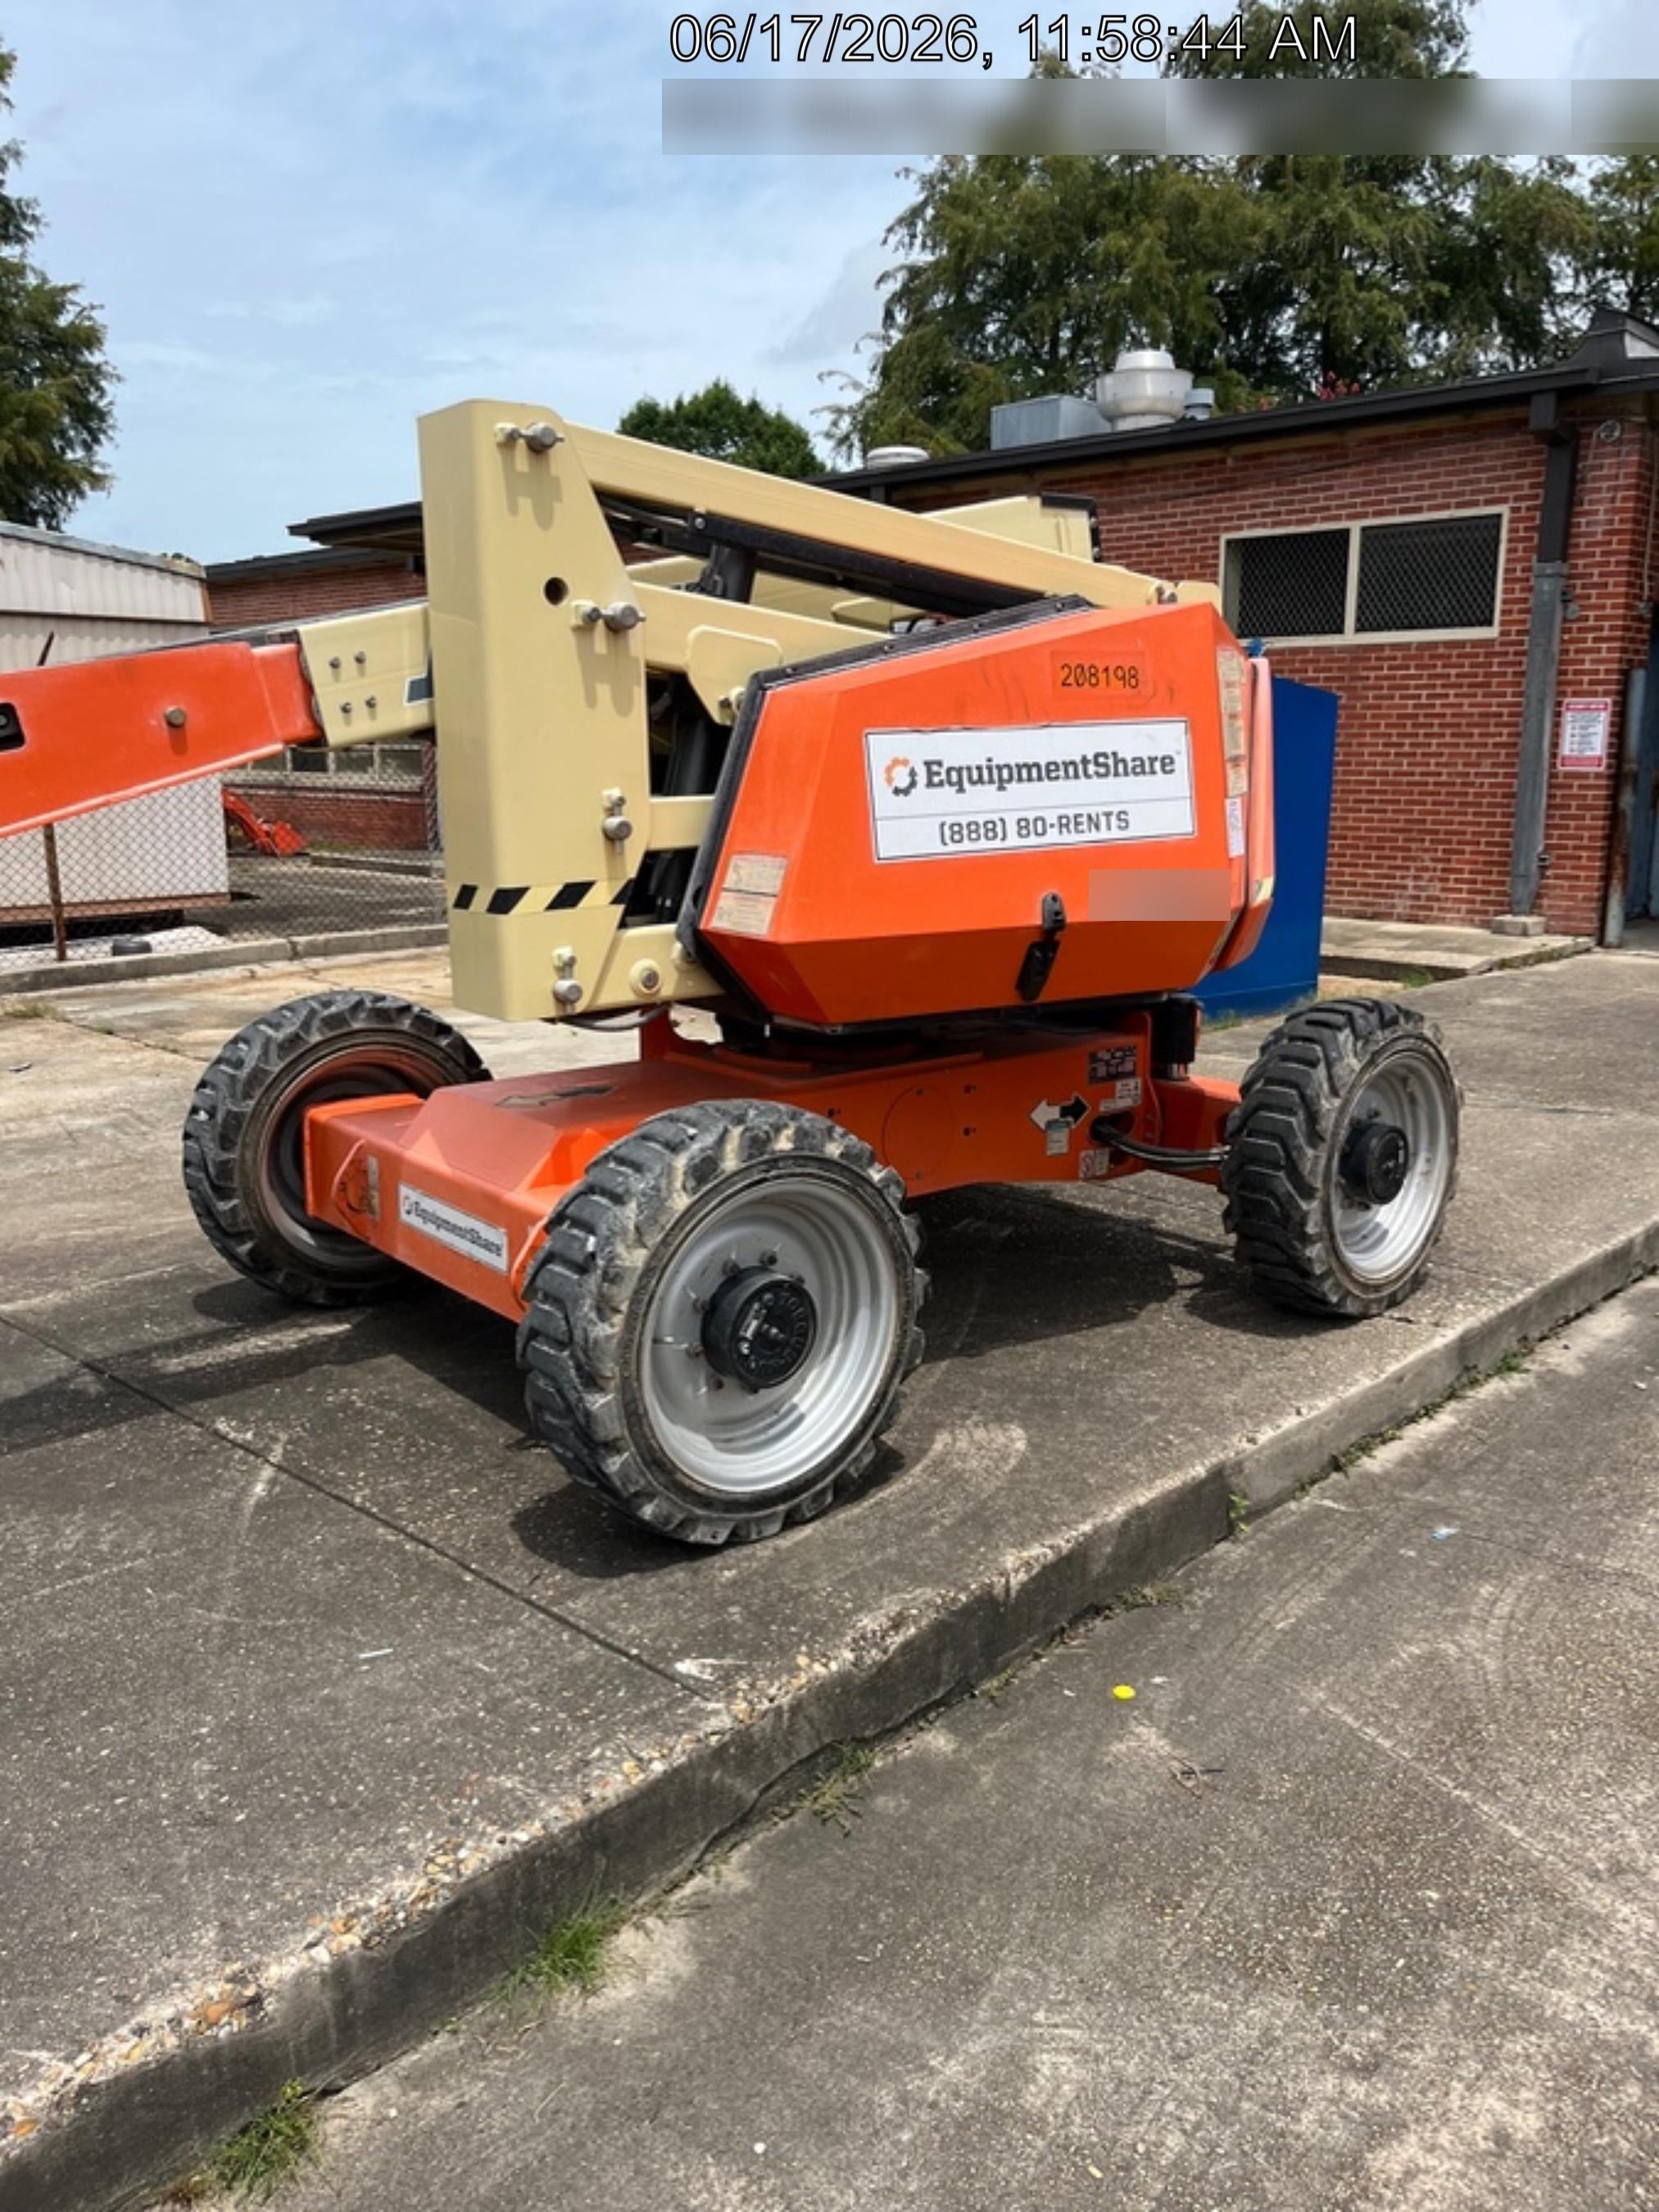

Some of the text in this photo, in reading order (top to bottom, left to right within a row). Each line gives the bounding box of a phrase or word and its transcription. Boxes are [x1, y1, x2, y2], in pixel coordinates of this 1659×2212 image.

[1060, 663, 1140, 689] 208198
[923, 751, 1176, 794] EquipmentShare
[940, 810, 1130, 845] (888) 80-RENTS
